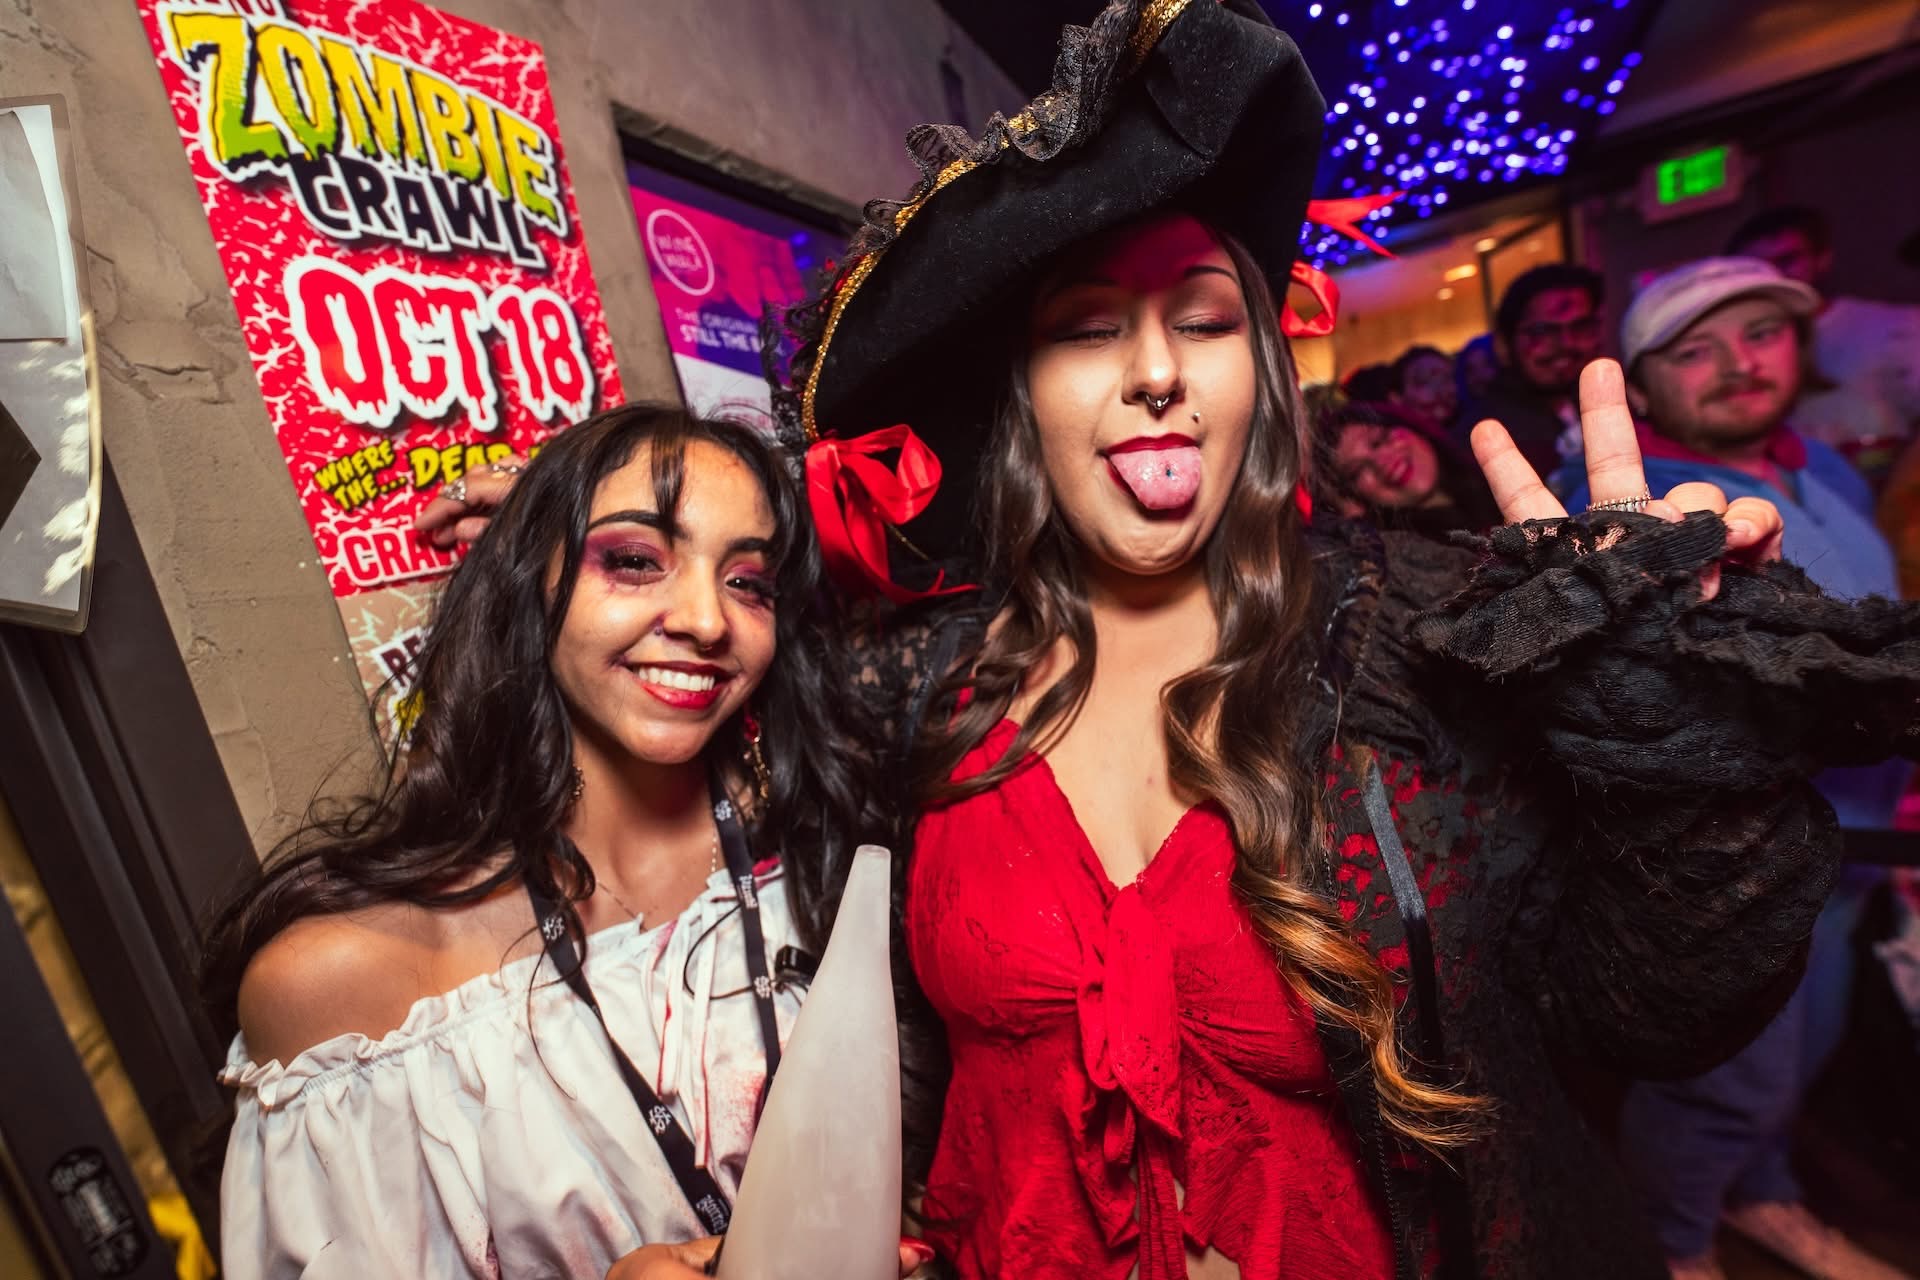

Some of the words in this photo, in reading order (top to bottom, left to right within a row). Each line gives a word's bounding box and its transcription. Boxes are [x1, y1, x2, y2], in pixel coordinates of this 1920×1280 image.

[165, 9, 563, 228] ZOMBIE
[289, 154, 543, 265] CRAWL
[291, 263, 494, 427] OCT
[494, 290, 591, 421] 18
[314, 438, 396, 490] WHERE
[342, 524, 474, 585] CRA
